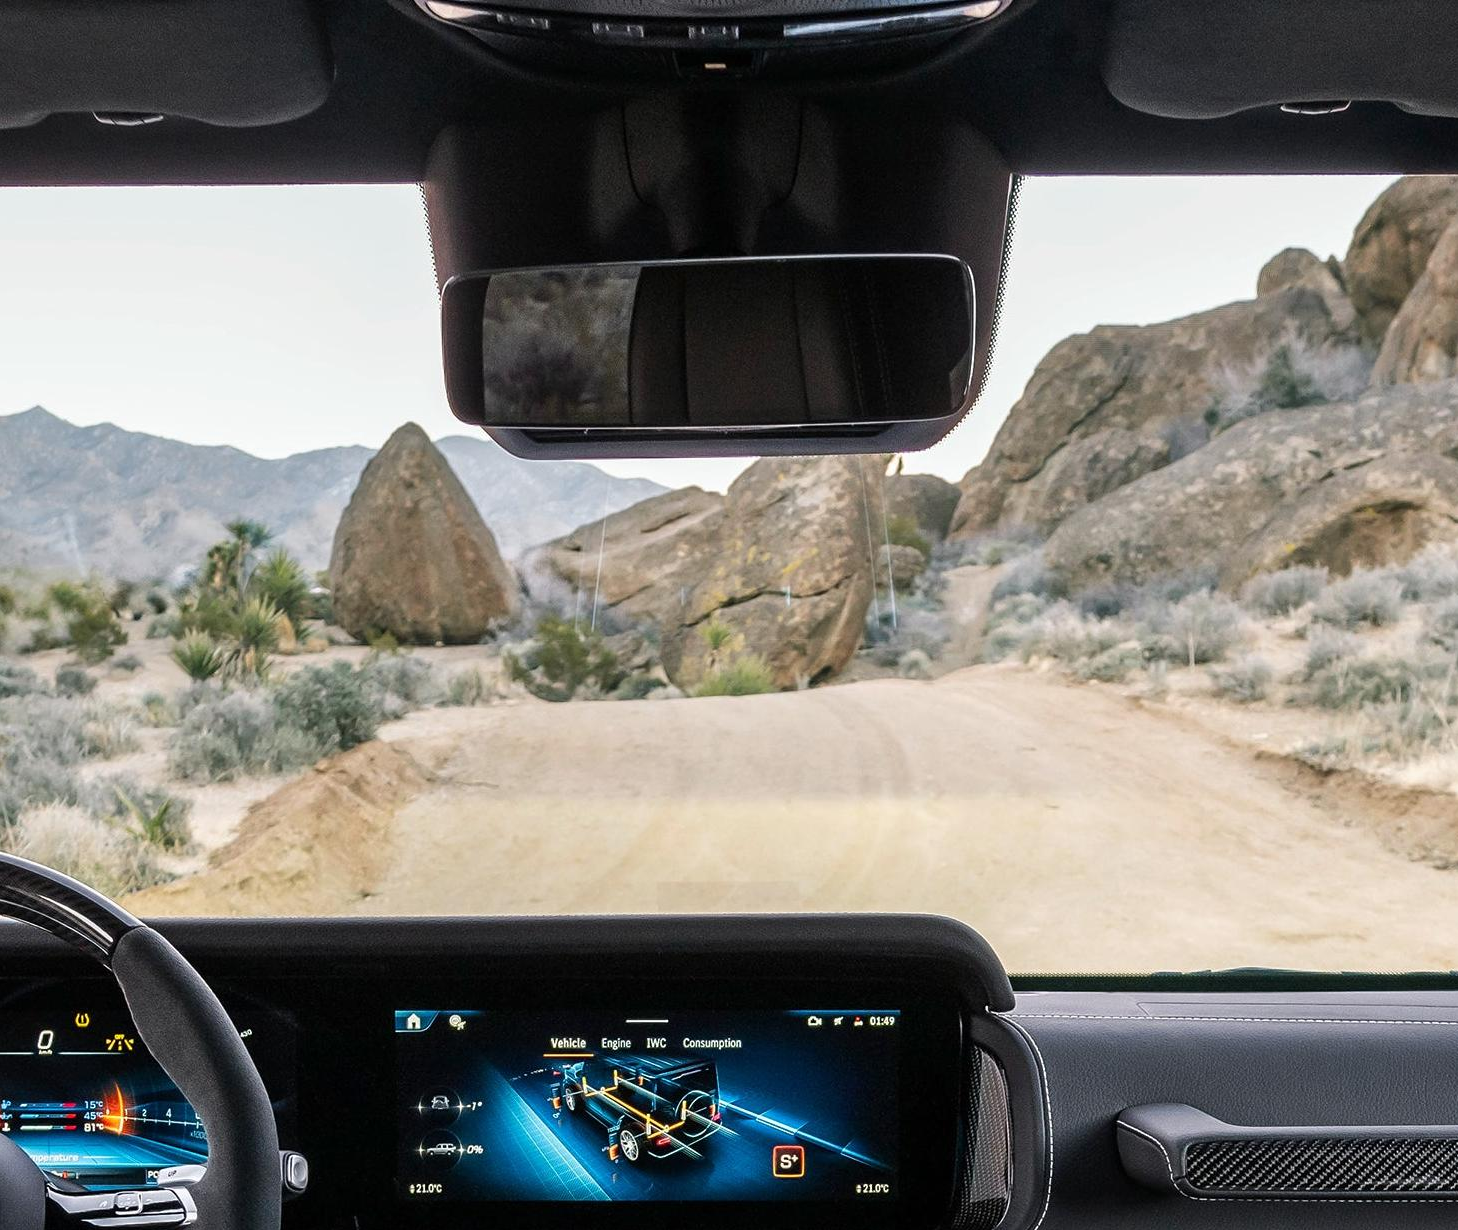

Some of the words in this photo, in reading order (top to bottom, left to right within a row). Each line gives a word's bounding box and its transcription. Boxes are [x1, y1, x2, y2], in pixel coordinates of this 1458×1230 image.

[870, 1016, 895, 1026] 01:49
[37, 1029, 54, 1050] 0
[551, 1037, 587, 1049] Vehicle
[601, 1037, 632, 1051] Engine
[646, 1038, 667, 1049] IWC
[682, 1037, 743, 1051] Consumption
[165, 1108, 173, 1119] 4
[83, 1122, 105, 1132] 81°C
[466, 1144, 484, 1155] 0%
[415, 1183, 443, 1194] 21.0°C
[862, 1183, 890, 1193] 21.0°C
